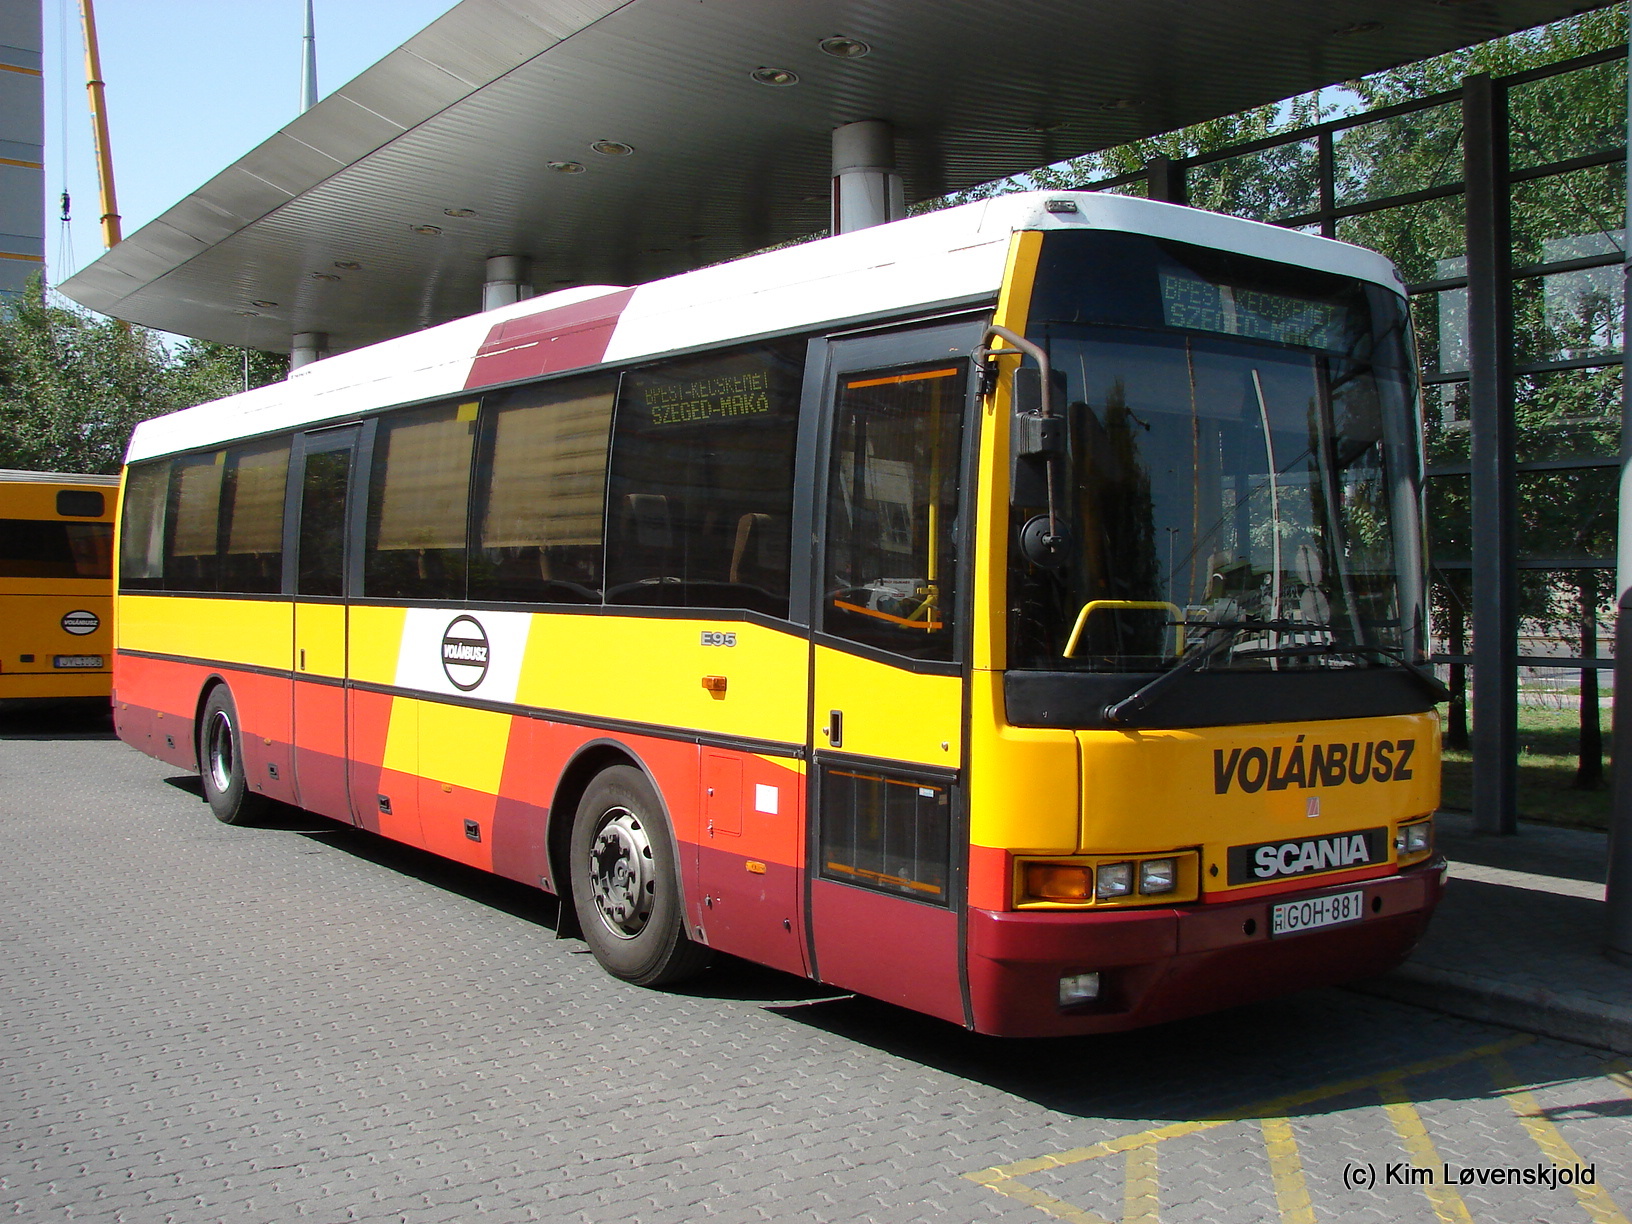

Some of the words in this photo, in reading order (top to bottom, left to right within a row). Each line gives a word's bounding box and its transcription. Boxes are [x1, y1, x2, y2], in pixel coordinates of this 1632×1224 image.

[651, 391, 769, 425] SZEGED-MAKÓ
[444, 641, 488, 662] VOLÁNBUSZ
[701, 631, 737, 647] E95
[1213, 735, 1415, 795] VOLÁNBUSZ
[1253, 834, 1370, 878] SCANIA
[1287, 894, 1362, 928] GOH-881
